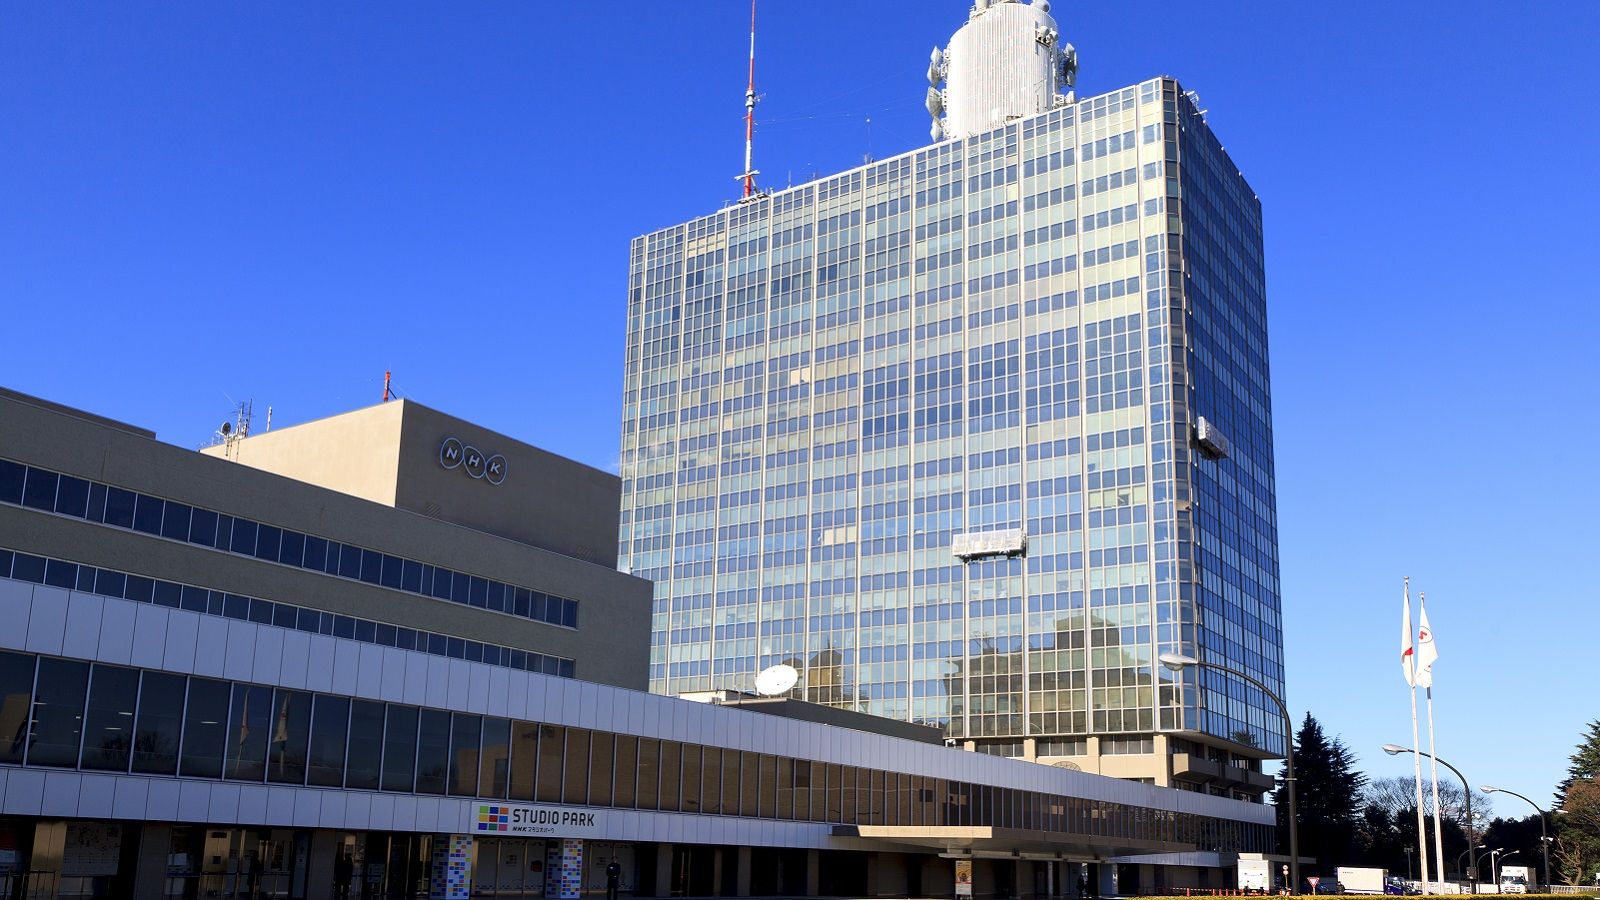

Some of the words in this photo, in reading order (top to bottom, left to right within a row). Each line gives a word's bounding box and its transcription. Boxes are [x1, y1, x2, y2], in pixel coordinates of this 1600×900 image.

[445, 446, 502, 476] NHK
[512, 808, 560, 825] STUDIO
[562, 811, 595, 827] PARK
